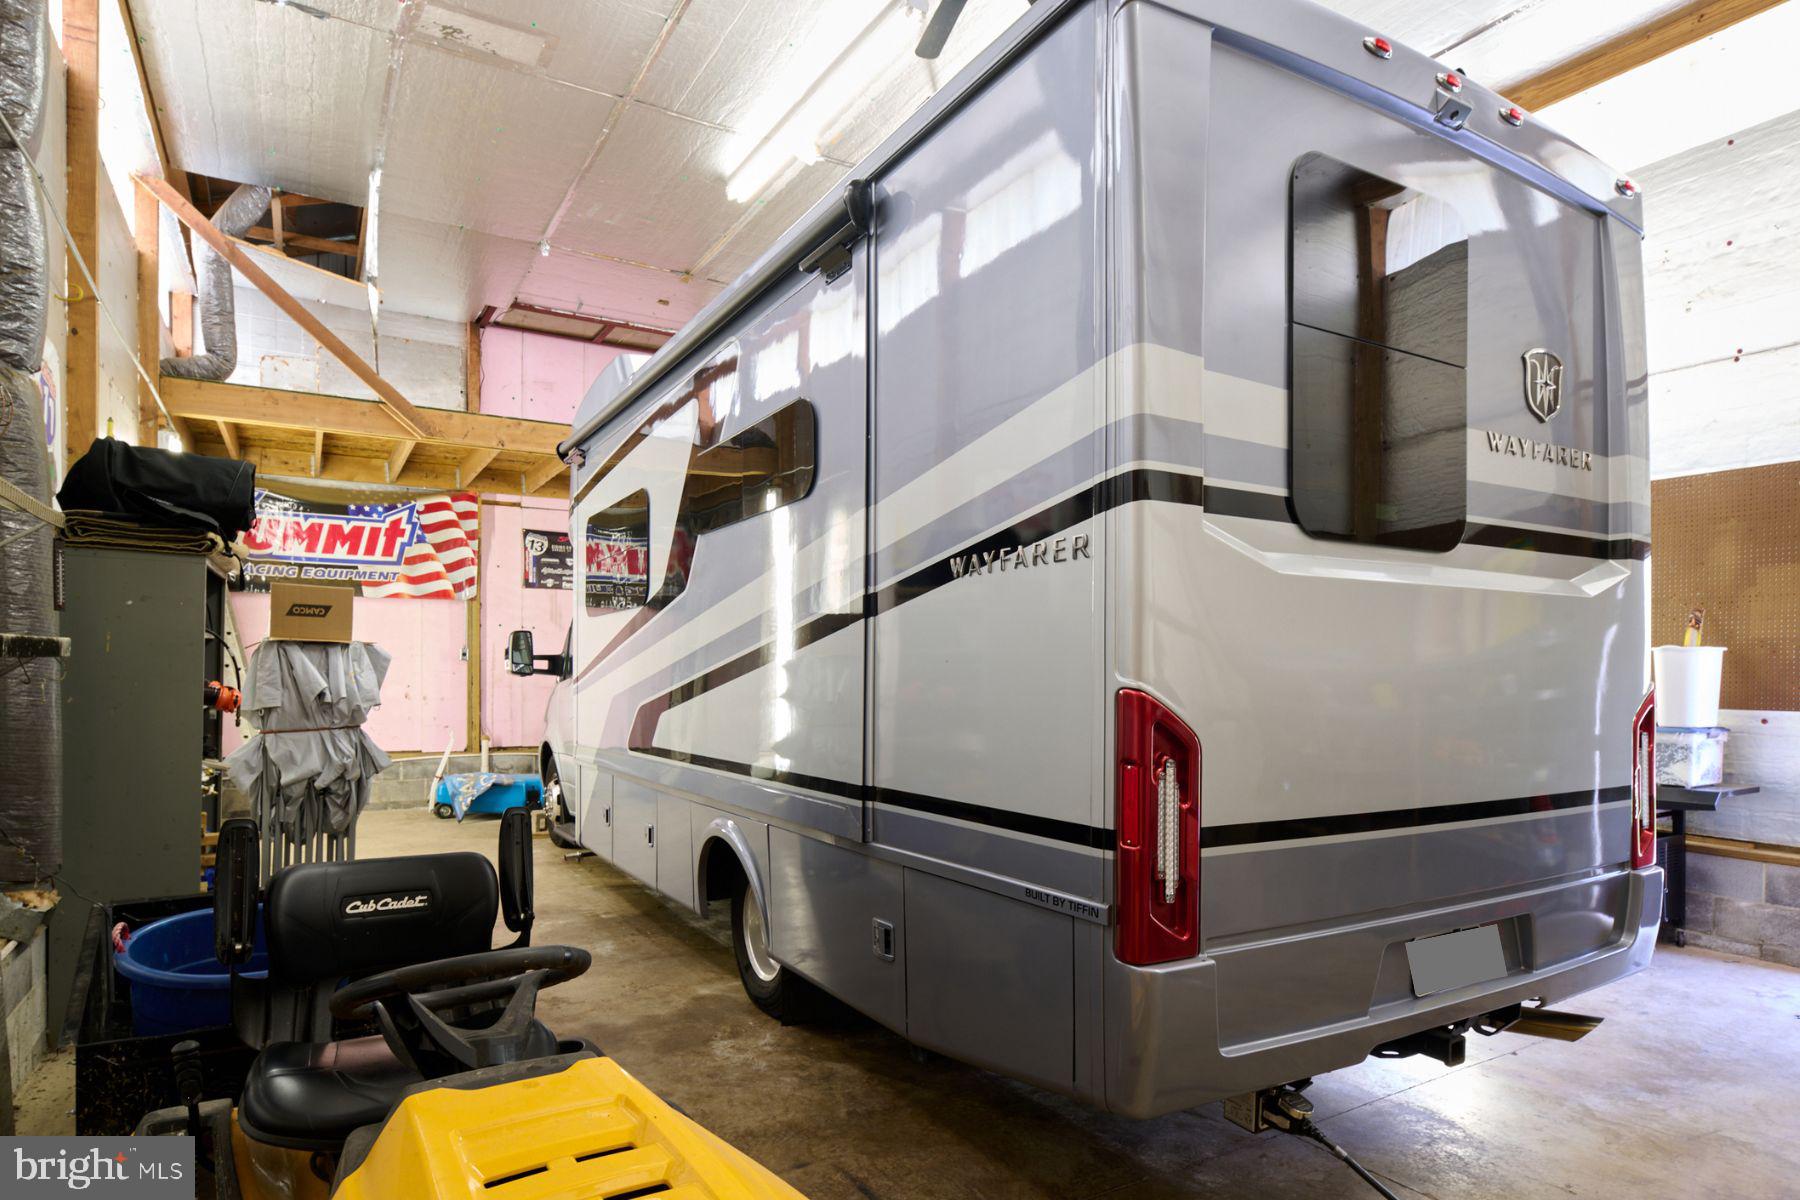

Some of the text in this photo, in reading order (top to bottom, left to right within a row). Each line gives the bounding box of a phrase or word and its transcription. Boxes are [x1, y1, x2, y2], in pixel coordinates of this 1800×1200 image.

[1487, 431, 1592, 471] WAYFARER
[528, 539, 545, 553] 13
[950, 533, 1090, 578] WAYFARER
[242, 563, 400, 581] ACING EQUIPMENT
[292, 606, 326, 616] CAMCO
[345, 895, 428, 914] Cub Cadet
[1025, 888, 1099, 918] BUILT BY TIFFIN
